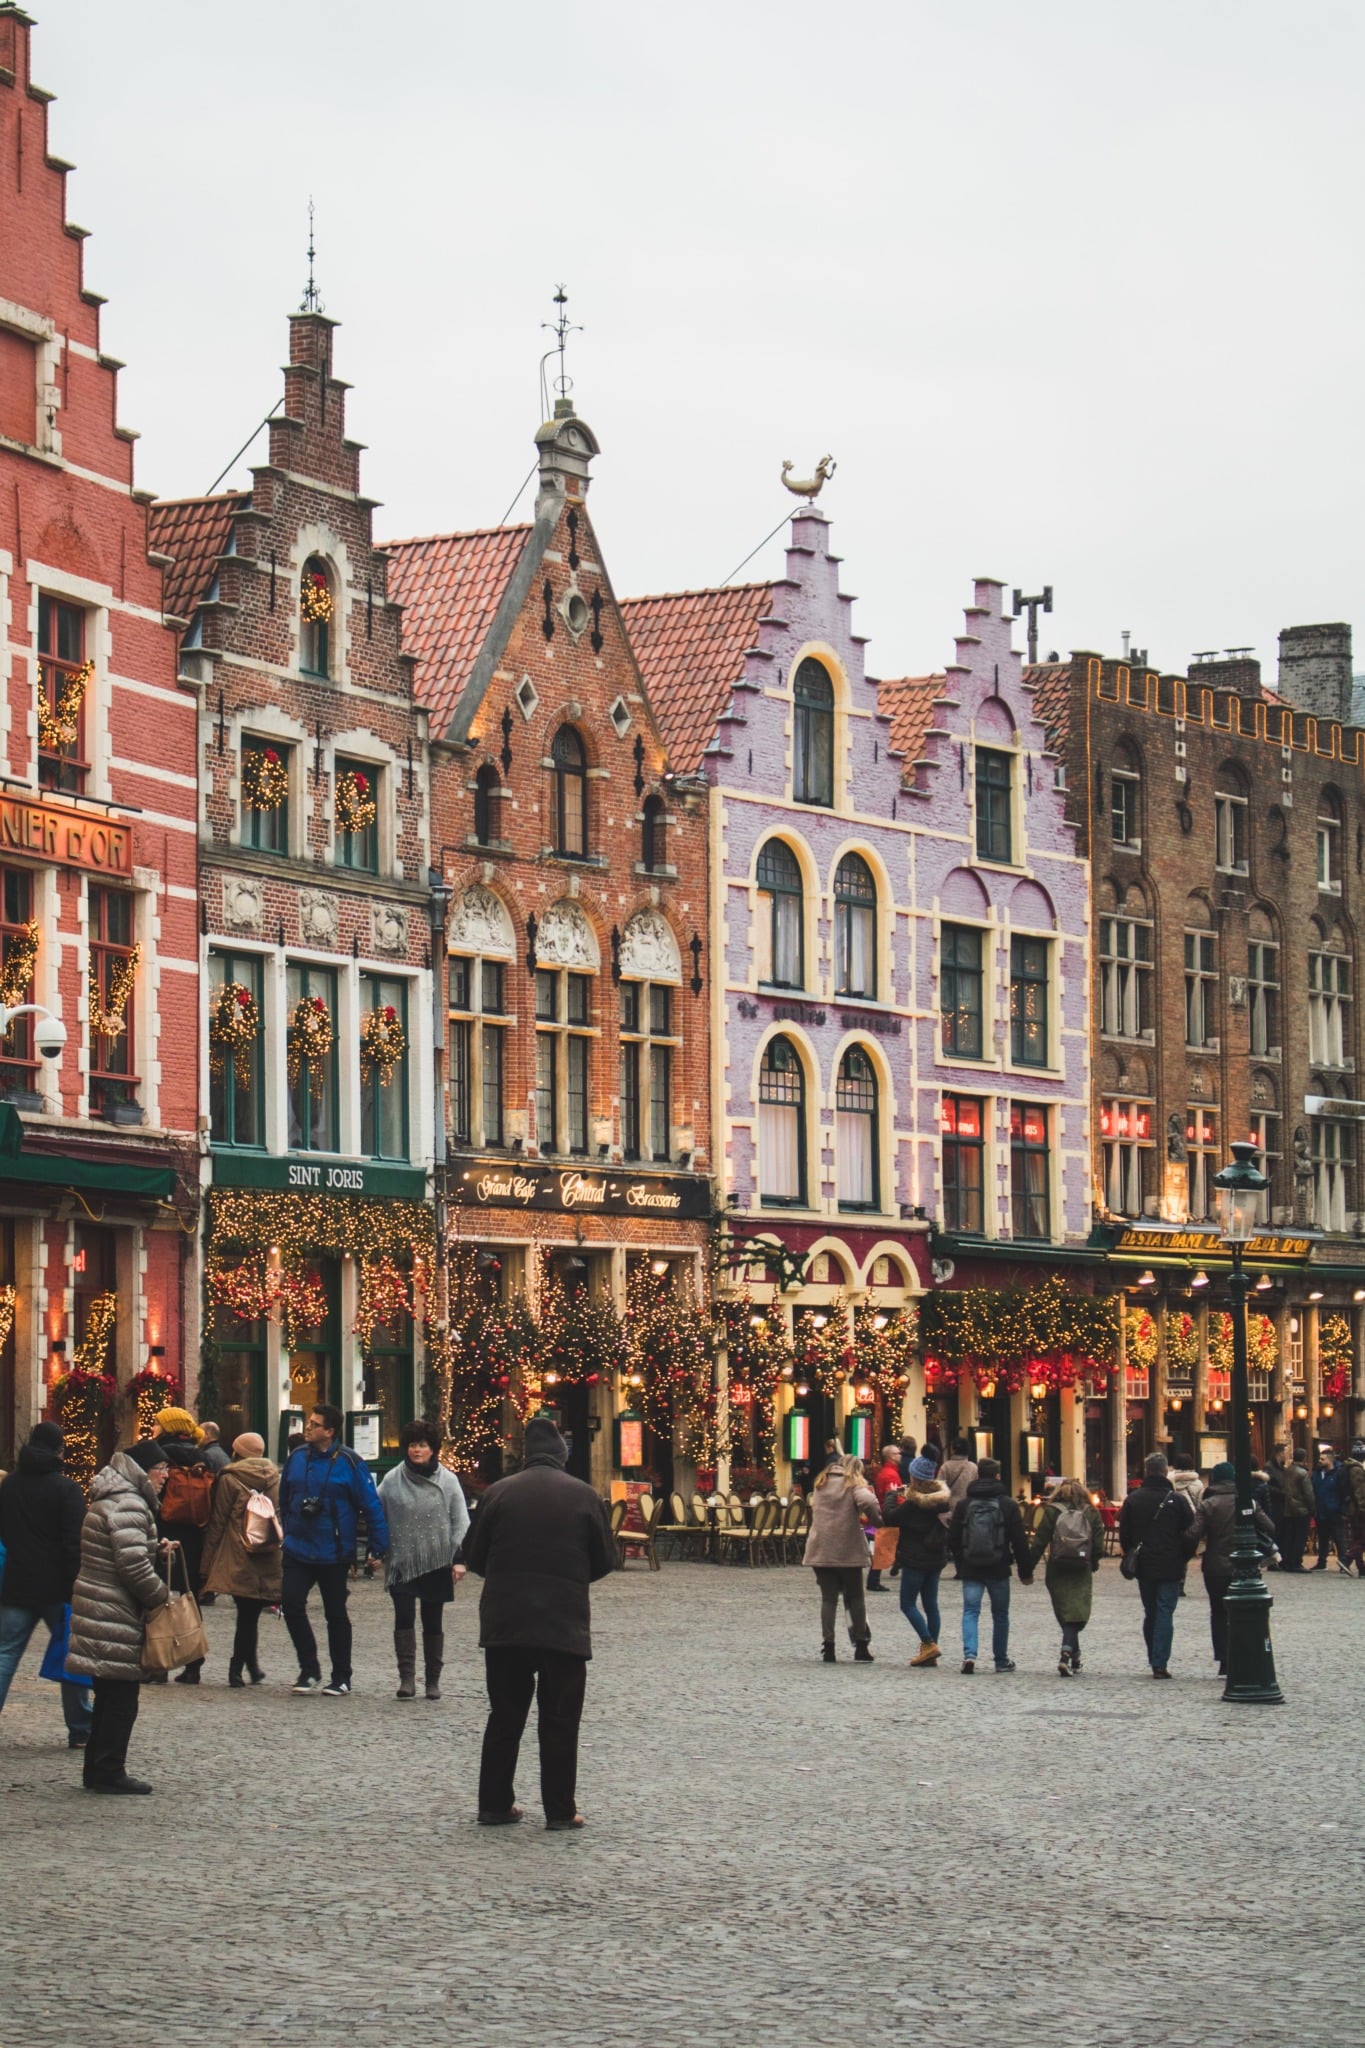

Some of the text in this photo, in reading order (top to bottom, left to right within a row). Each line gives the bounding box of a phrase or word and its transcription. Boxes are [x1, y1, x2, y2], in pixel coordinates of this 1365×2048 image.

[288, 1165, 364, 1189] SINT JORIS
[477, 1174, 512, 1201] Grand
[559, 1172, 607, 1207] Central
[626, 1184, 681, 1208] Brasserie
[1120, 1231, 1201, 1249] RESTAURANT
